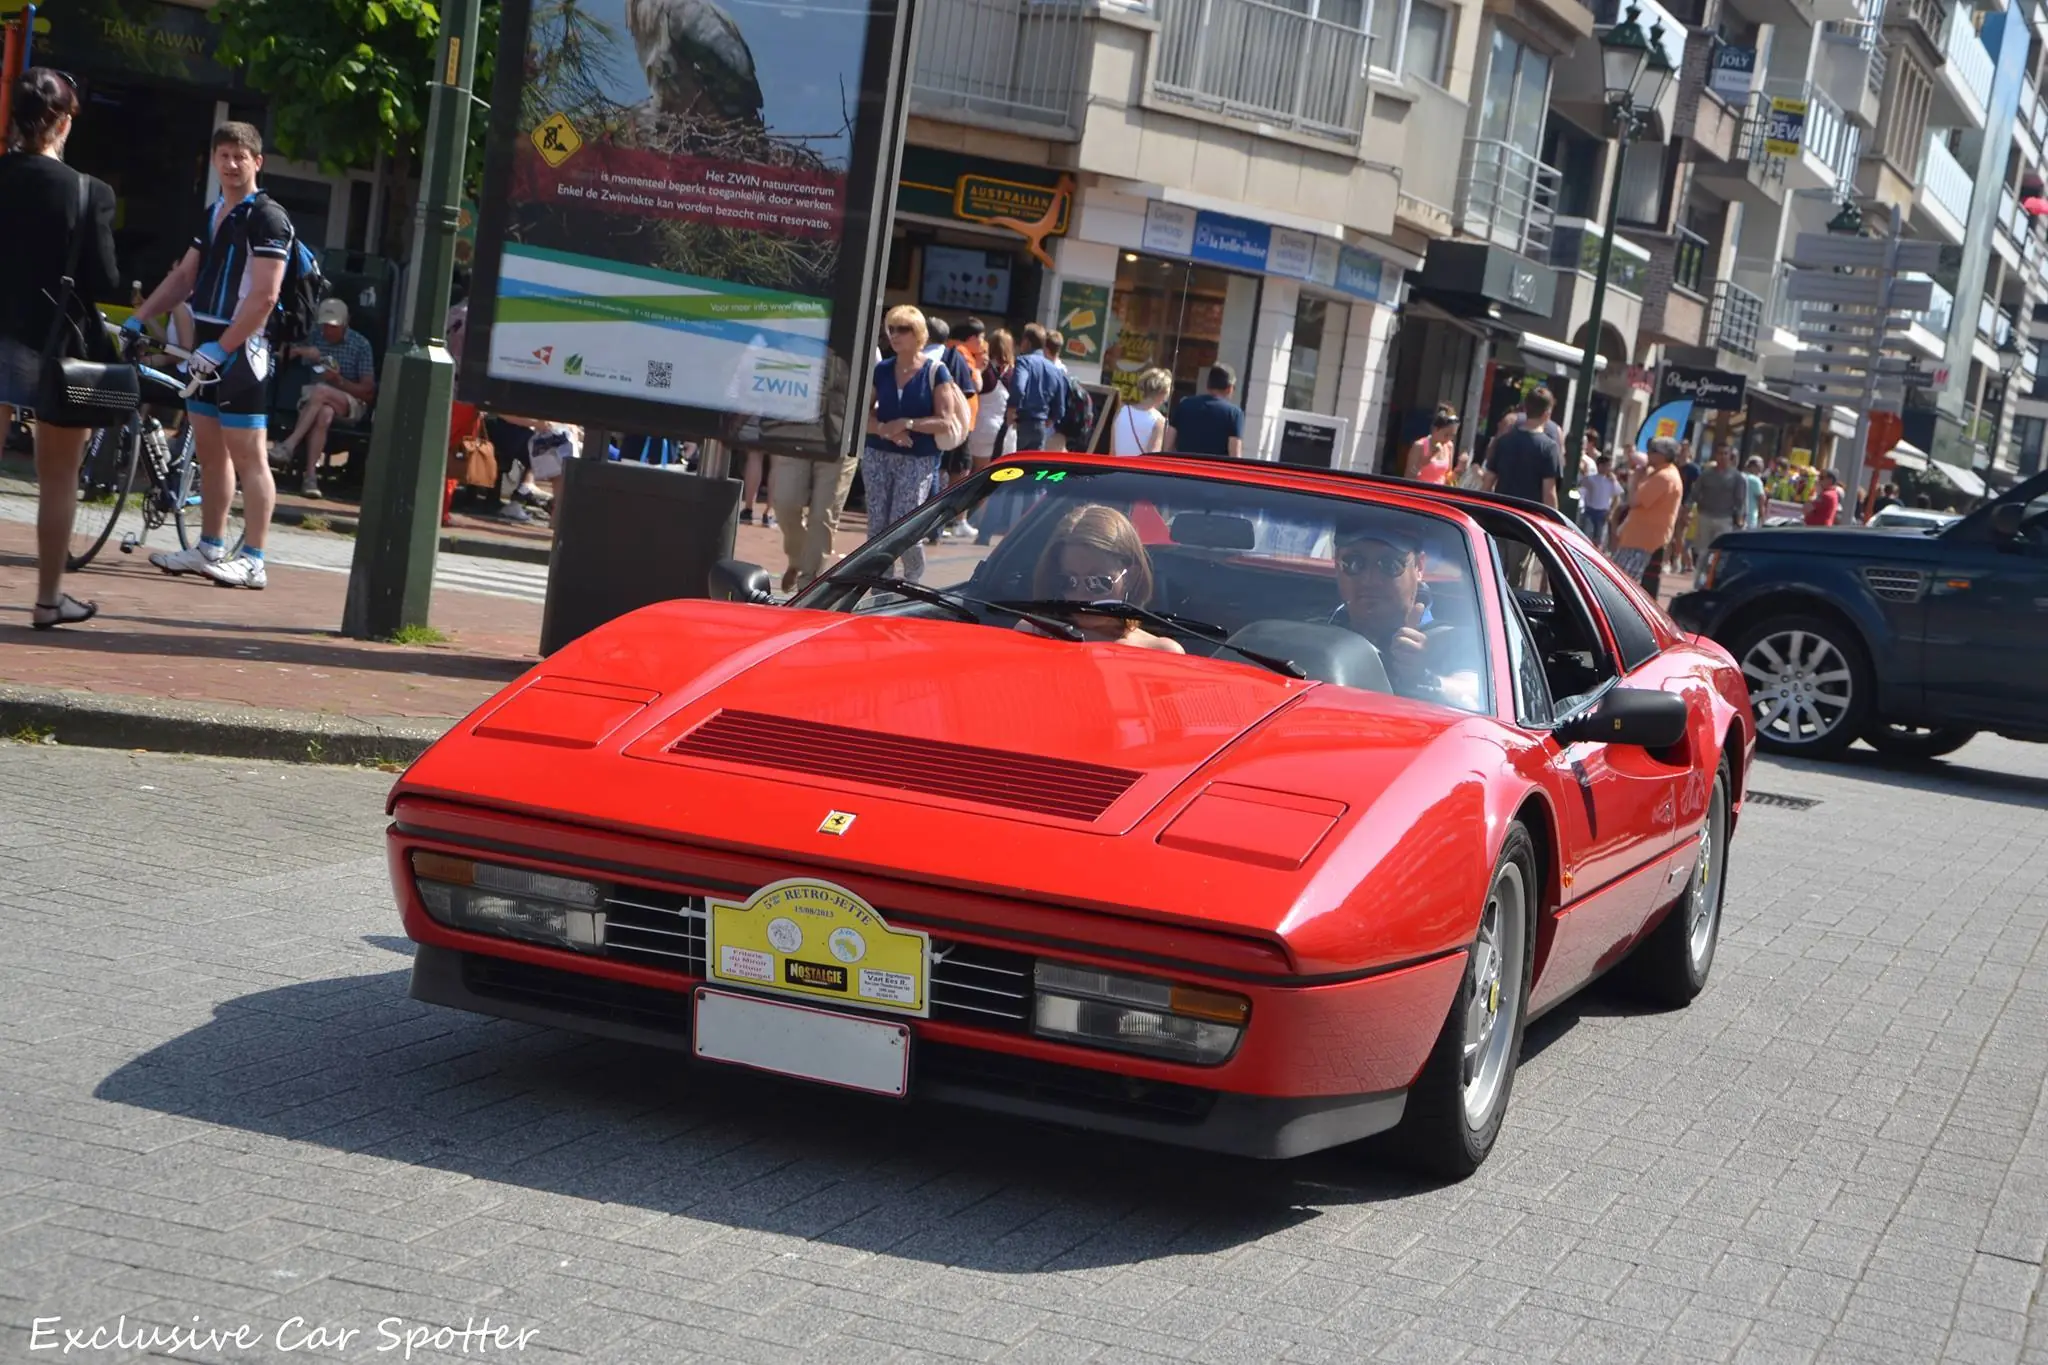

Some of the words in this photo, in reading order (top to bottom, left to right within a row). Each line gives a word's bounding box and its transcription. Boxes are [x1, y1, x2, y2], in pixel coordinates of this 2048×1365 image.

[102, 18, 147, 43] TAKE
[153, 29, 206, 53] AWAY
[1720, 53, 1749, 67] JOLY
[600, 170, 609, 182] is
[611, 173, 666, 190] momenteel
[668, 181, 706, 195] beperkt
[708, 186, 766, 204] toegankelijk
[768, 193, 793, 205] door
[796, 198, 835, 211] werken.
[705, 169, 725, 182] Het
[727, 172, 760, 187] ZWIN
[762, 178, 835, 197] natuurcentrum
[556, 182, 584, 197] Enkel
[585, 187, 598, 200] de
[600, 189, 655, 207] Zwinvlakte
[656, 196, 674, 209] kan
[676, 200, 713, 215] worden
[715, 203, 755, 219] bezocht
[756, 211, 778, 223] mits
[780, 215, 832, 230] reservatie.
[970, 185, 1050, 208] AUSTRALIAN
[709, 302, 729, 312] Voor
[752, 302, 767, 312] info
[751, 375, 809, 398] ZWIN
[1034, 469, 1068, 482] 14
[784, 888, 872, 926] RETRO-JETTE
[790, 963, 842, 985] NOSTALGIE
